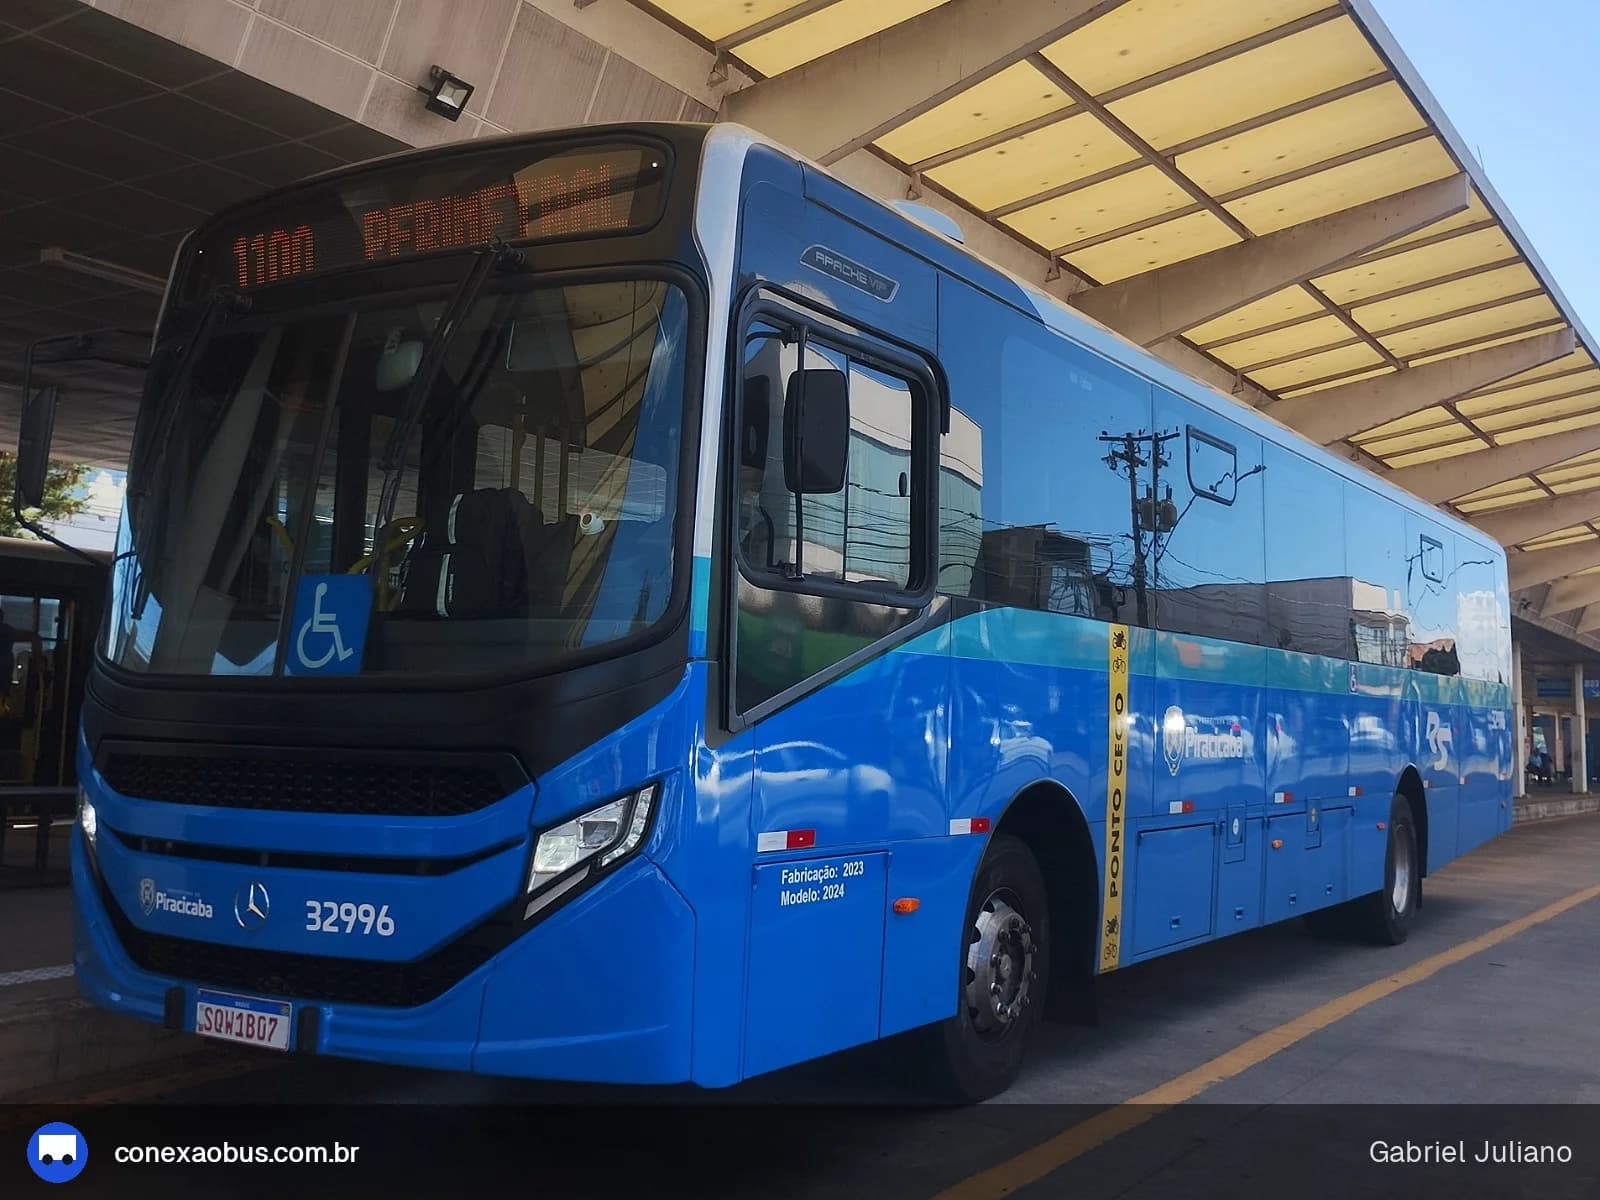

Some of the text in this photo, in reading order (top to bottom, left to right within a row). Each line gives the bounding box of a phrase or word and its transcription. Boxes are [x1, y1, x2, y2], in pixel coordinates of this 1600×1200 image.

[233, 224, 314, 288] 1100
[815, 251, 868, 285] APACHE
[1185, 726, 1243, 758] Piracicaba
[1110, 788, 1121, 898] PONTO
[781, 860, 864, 885] Fabricação: 2023
[156, 891, 214, 919] Piracicaba
[780, 882, 845, 906] Modelo: 2024
[305, 900, 395, 936] 32996
[203, 1006, 278, 1042] SQW1B07
